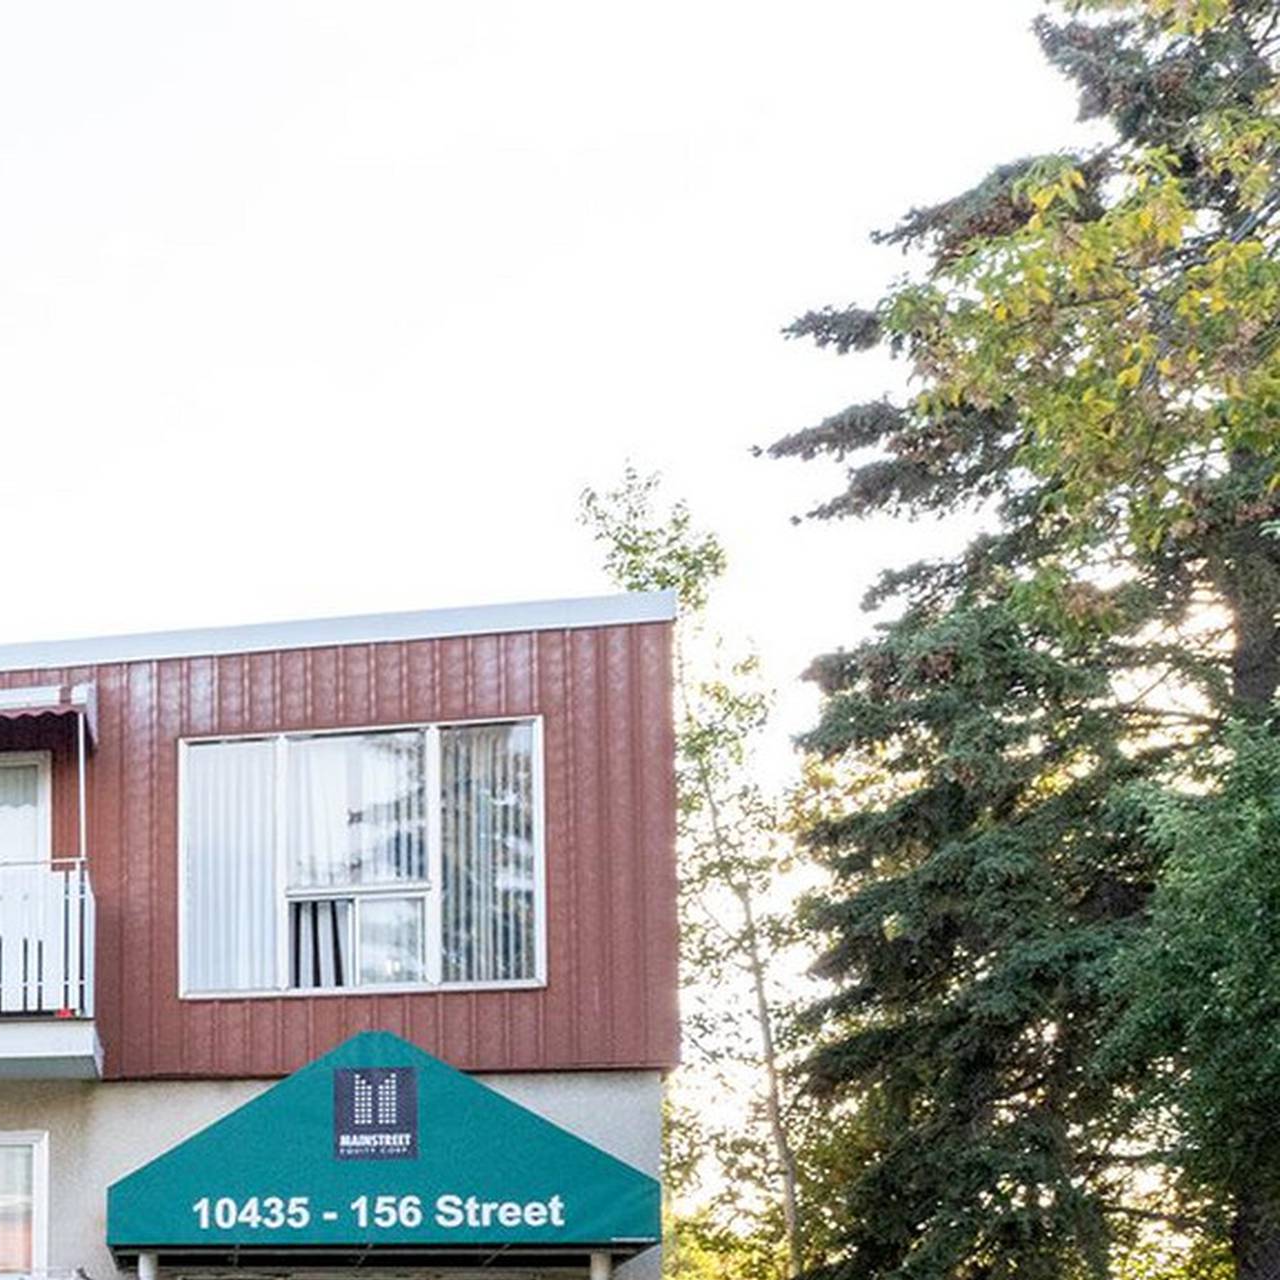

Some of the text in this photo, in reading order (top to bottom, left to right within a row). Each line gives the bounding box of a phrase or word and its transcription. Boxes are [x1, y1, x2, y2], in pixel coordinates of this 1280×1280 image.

[339, 1133, 411, 1147] MAINSTREET
[193, 1197, 310, 1229] 10435
[350, 1196, 422, 1228] 156
[435, 1194, 565, 1227] Street
